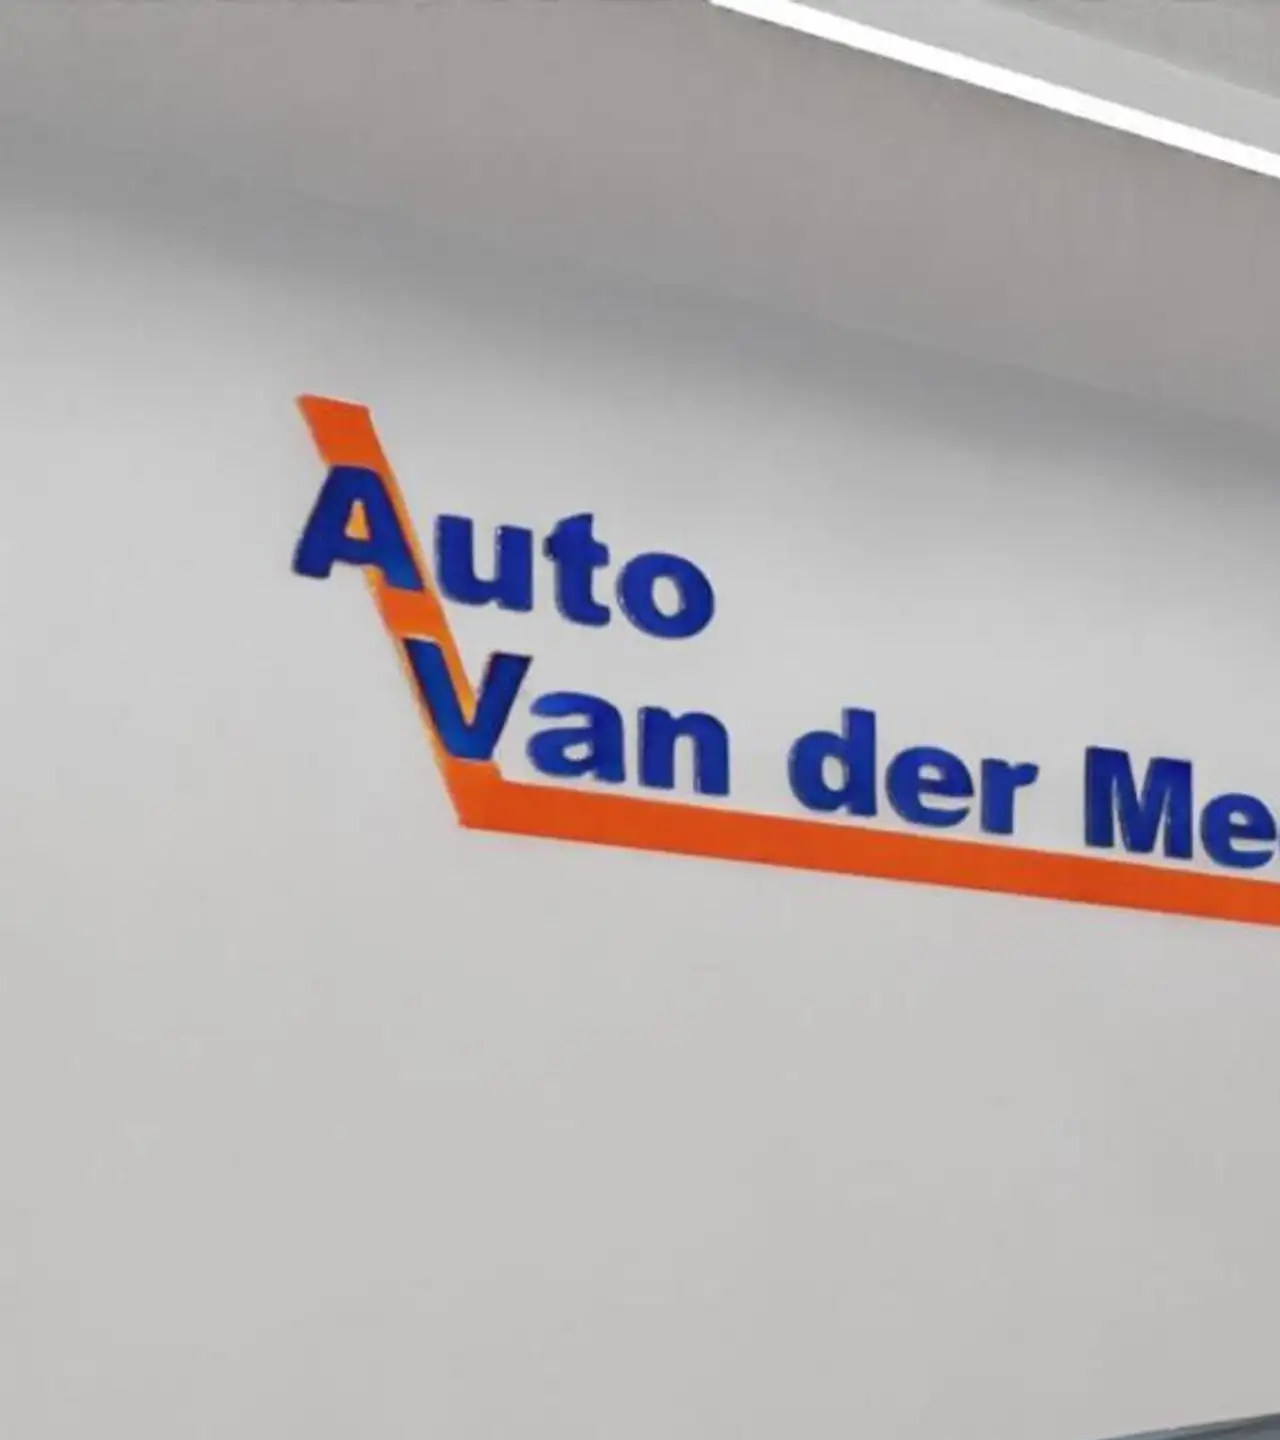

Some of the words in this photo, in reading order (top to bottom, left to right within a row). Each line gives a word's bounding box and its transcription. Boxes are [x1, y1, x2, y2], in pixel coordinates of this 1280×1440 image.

[292, 464, 716, 640] Auto
[402, 636, 730, 797] Van
[787, 706, 1039, 836] der
